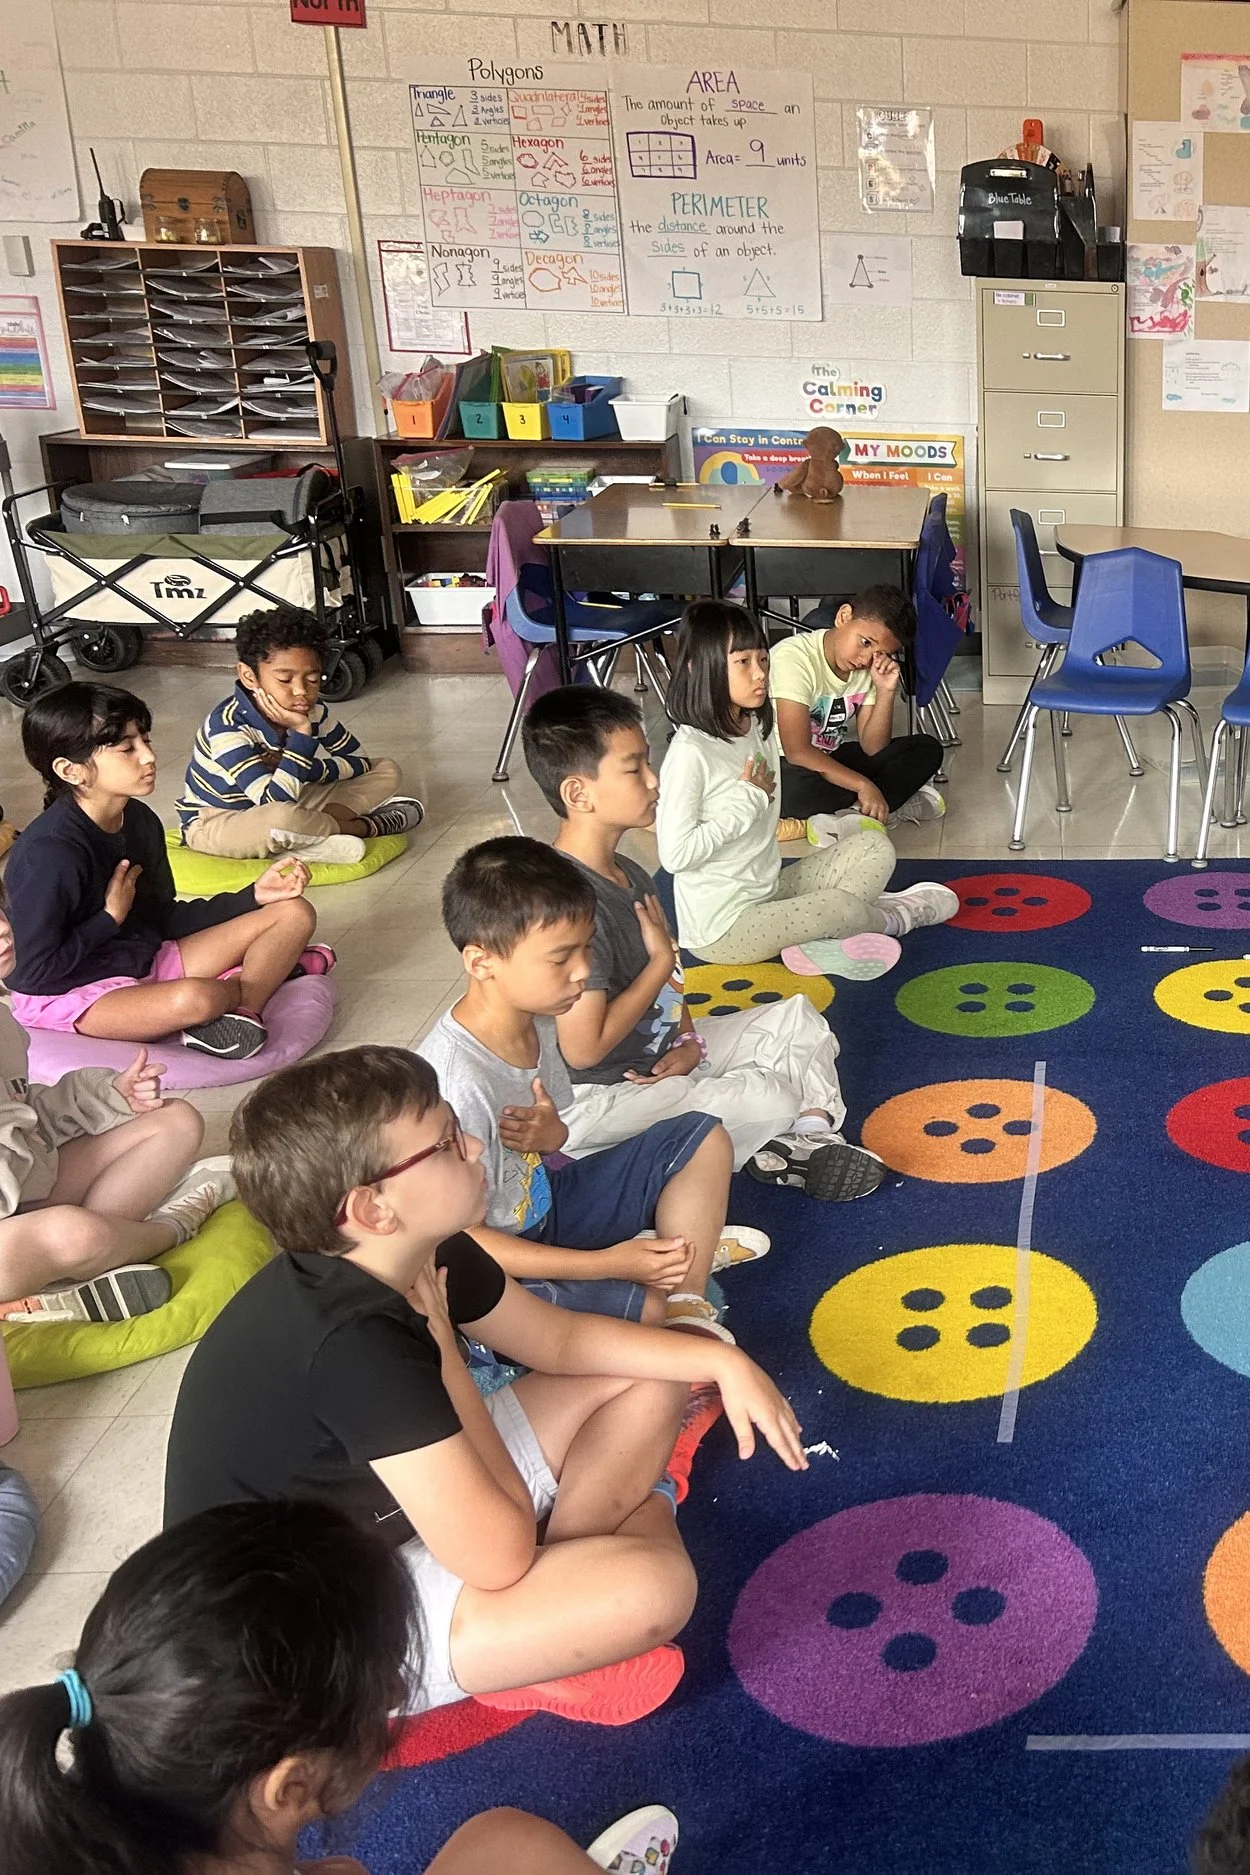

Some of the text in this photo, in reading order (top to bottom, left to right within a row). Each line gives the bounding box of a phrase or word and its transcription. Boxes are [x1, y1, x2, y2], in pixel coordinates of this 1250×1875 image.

[551, 21, 627, 57] MATH
[467, 57, 544, 86] Polygons
[686, 70, 740, 94] AREA
[411, 86, 456, 104] Triangle
[480, 93, 503, 103] sides
[622, 95, 800, 114] The amount of space an
[661, 115, 695, 130] Object
[700, 115, 729, 127] takes
[878, 110, 913, 122] CUBE
[416, 131, 471, 149] Pentagon
[513, 136, 564, 153] Hexagon
[705, 139, 807, 167] Area= 9 units
[423, 189, 491, 207] Heptagon
[519, 190, 578, 212] Octagon
[671, 192, 770, 219] PERIMETER
[988, 192, 1032, 206] Blue Table
[593, 212, 615, 221] sides
[630, 216, 785, 235] the distance around the
[431, 245, 490, 263] Nonagon
[694, 242, 709, 258] of
[715, 245, 730, 257] an
[502, 263, 523, 273] sides
[525, 251, 583, 269] Decagon
[814, 365, 837, 377] The
[802, 381, 882, 402] Calming
[809, 398, 878, 415] Corner
[411, 415, 416, 426] 1
[476, 414, 484, 425] 2
[519, 414, 526, 425] 3
[562, 414, 569, 425] 4
[704, 434, 726, 444] Can
[729, 434, 754, 447] Stay
[758, 435, 769, 445] in
[744, 453, 759, 462] Take
[770, 454, 787, 464] deep
[854, 443, 947, 459] MY MOODS
[851, 470, 880, 480] When
[887, 471, 909, 481] Feel
[933, 473, 952, 482] Can
[149, 581, 207, 599] Tmz
